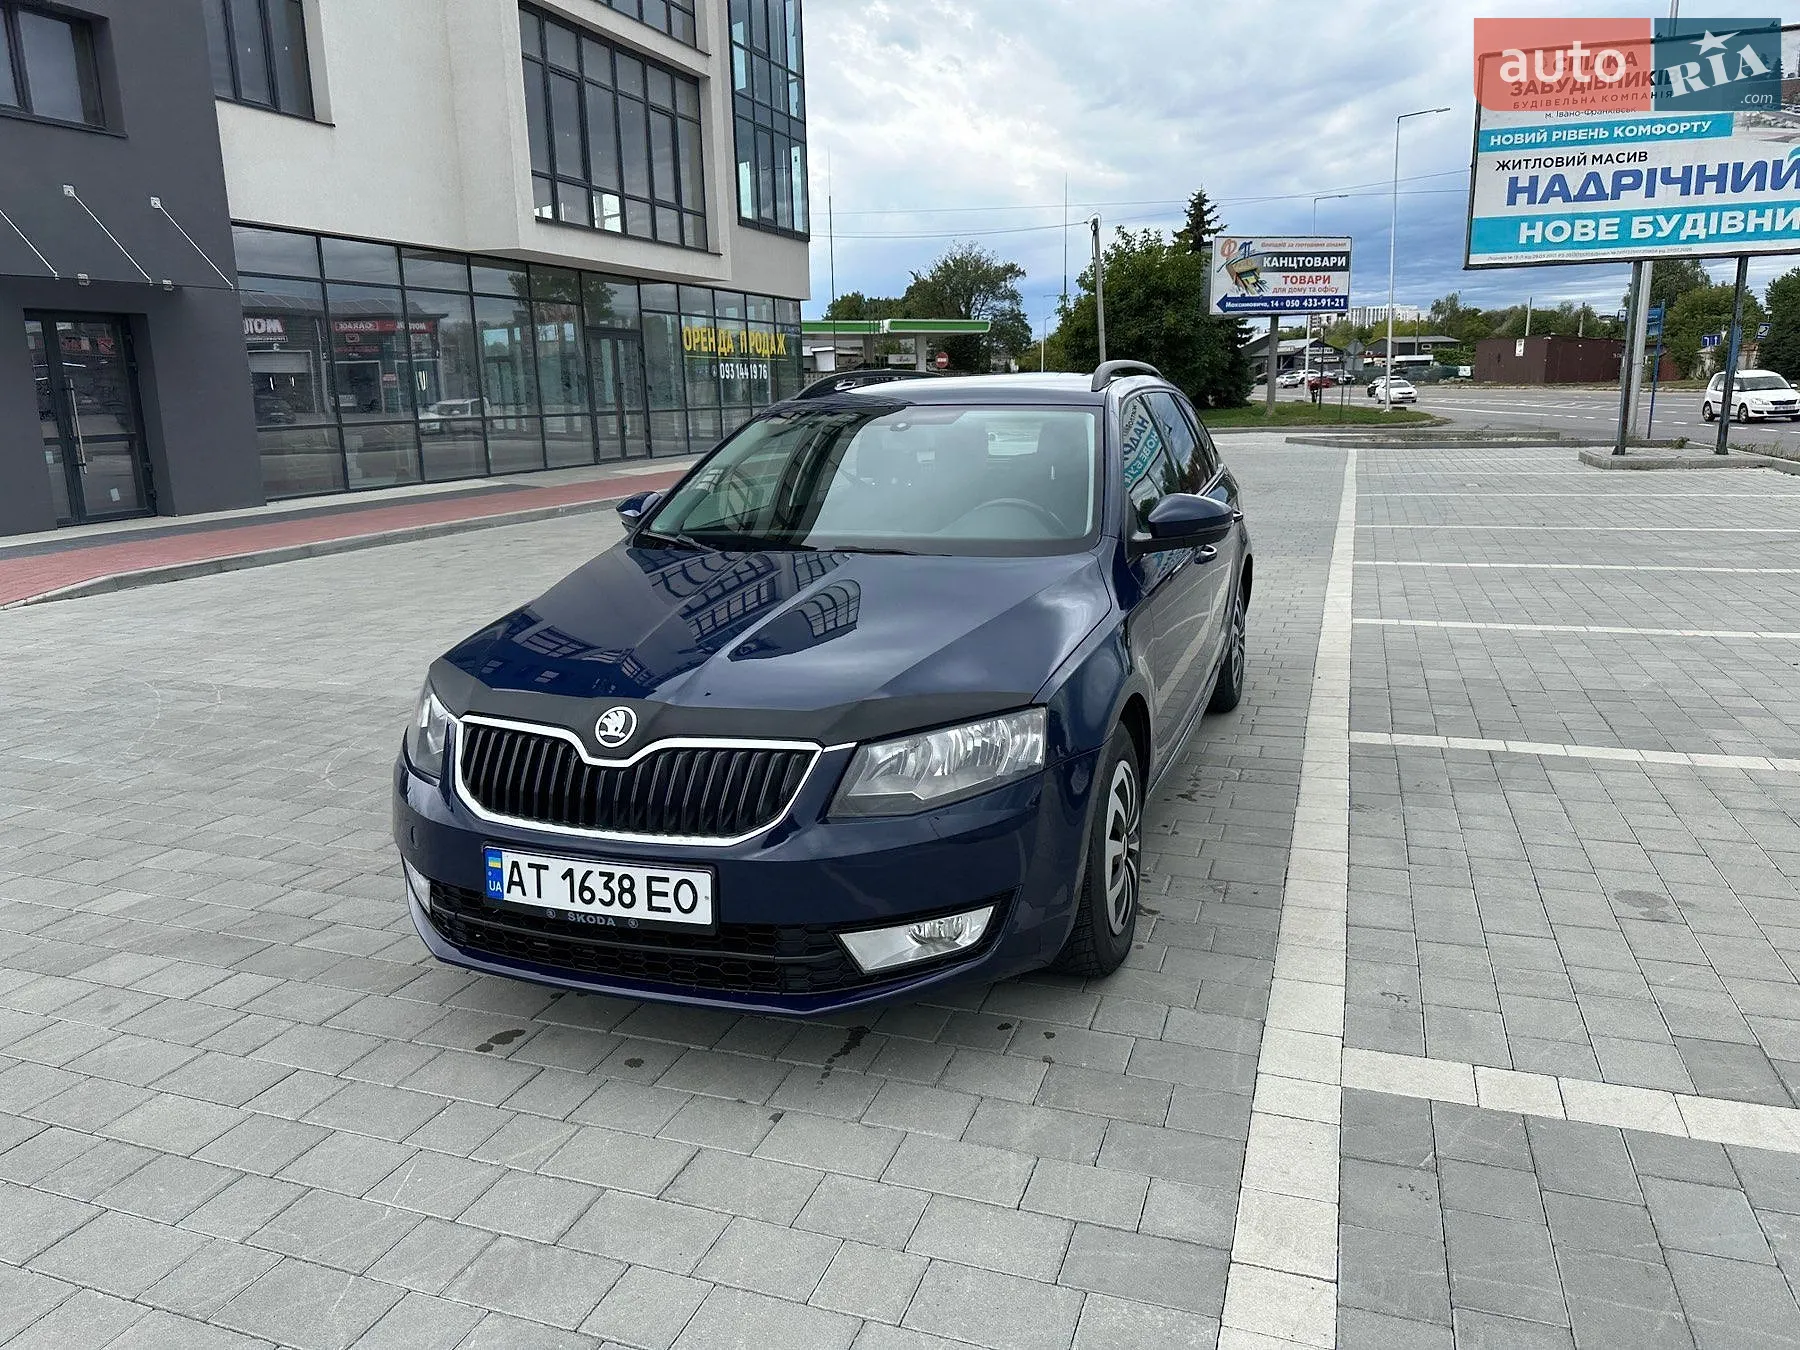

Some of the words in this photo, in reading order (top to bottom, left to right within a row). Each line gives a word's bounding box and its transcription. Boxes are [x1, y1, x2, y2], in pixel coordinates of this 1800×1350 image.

[1513, 96, 1597, 110] БУДІВЕЛЬНА
[1600, 90, 1674, 103] КОМПАНІЯ
[1490, 130, 1548, 146] НОВИЙ
[1551, 127, 1609, 143] РІВЕНЬ
[1612, 121, 1713, 139] КОМФОРТУ
[1495, 152, 1588, 172] ЖИТЛОВИЙ
[1591, 150, 1649, 166] МАСИВ
[1518, 217, 1621, 244] НОВЕ
[1263, 256, 1347, 269] КАНЦТОВАРИ
[1282, 275, 1331, 285] ТОВАРИ
[1318, 286, 1339, 294] офісу
[1270, 300, 1279, 308] 14
[1285, 299, 1300, 308] 050
[1302, 298, 1345, 308] 433-91-21
[683, 326, 735, 356] ОРЕНДА
[740, 329, 787, 358] ПРОДАЖ
[720, 363, 735, 379] 093
[759, 364, 768, 379] 76
[488, 879, 503, 893] UA
[506, 860, 550, 899] AT
[561, 867, 637, 910] 1638
[646, 875, 699, 915] EO
[567, 912, 616, 927] SKODA
